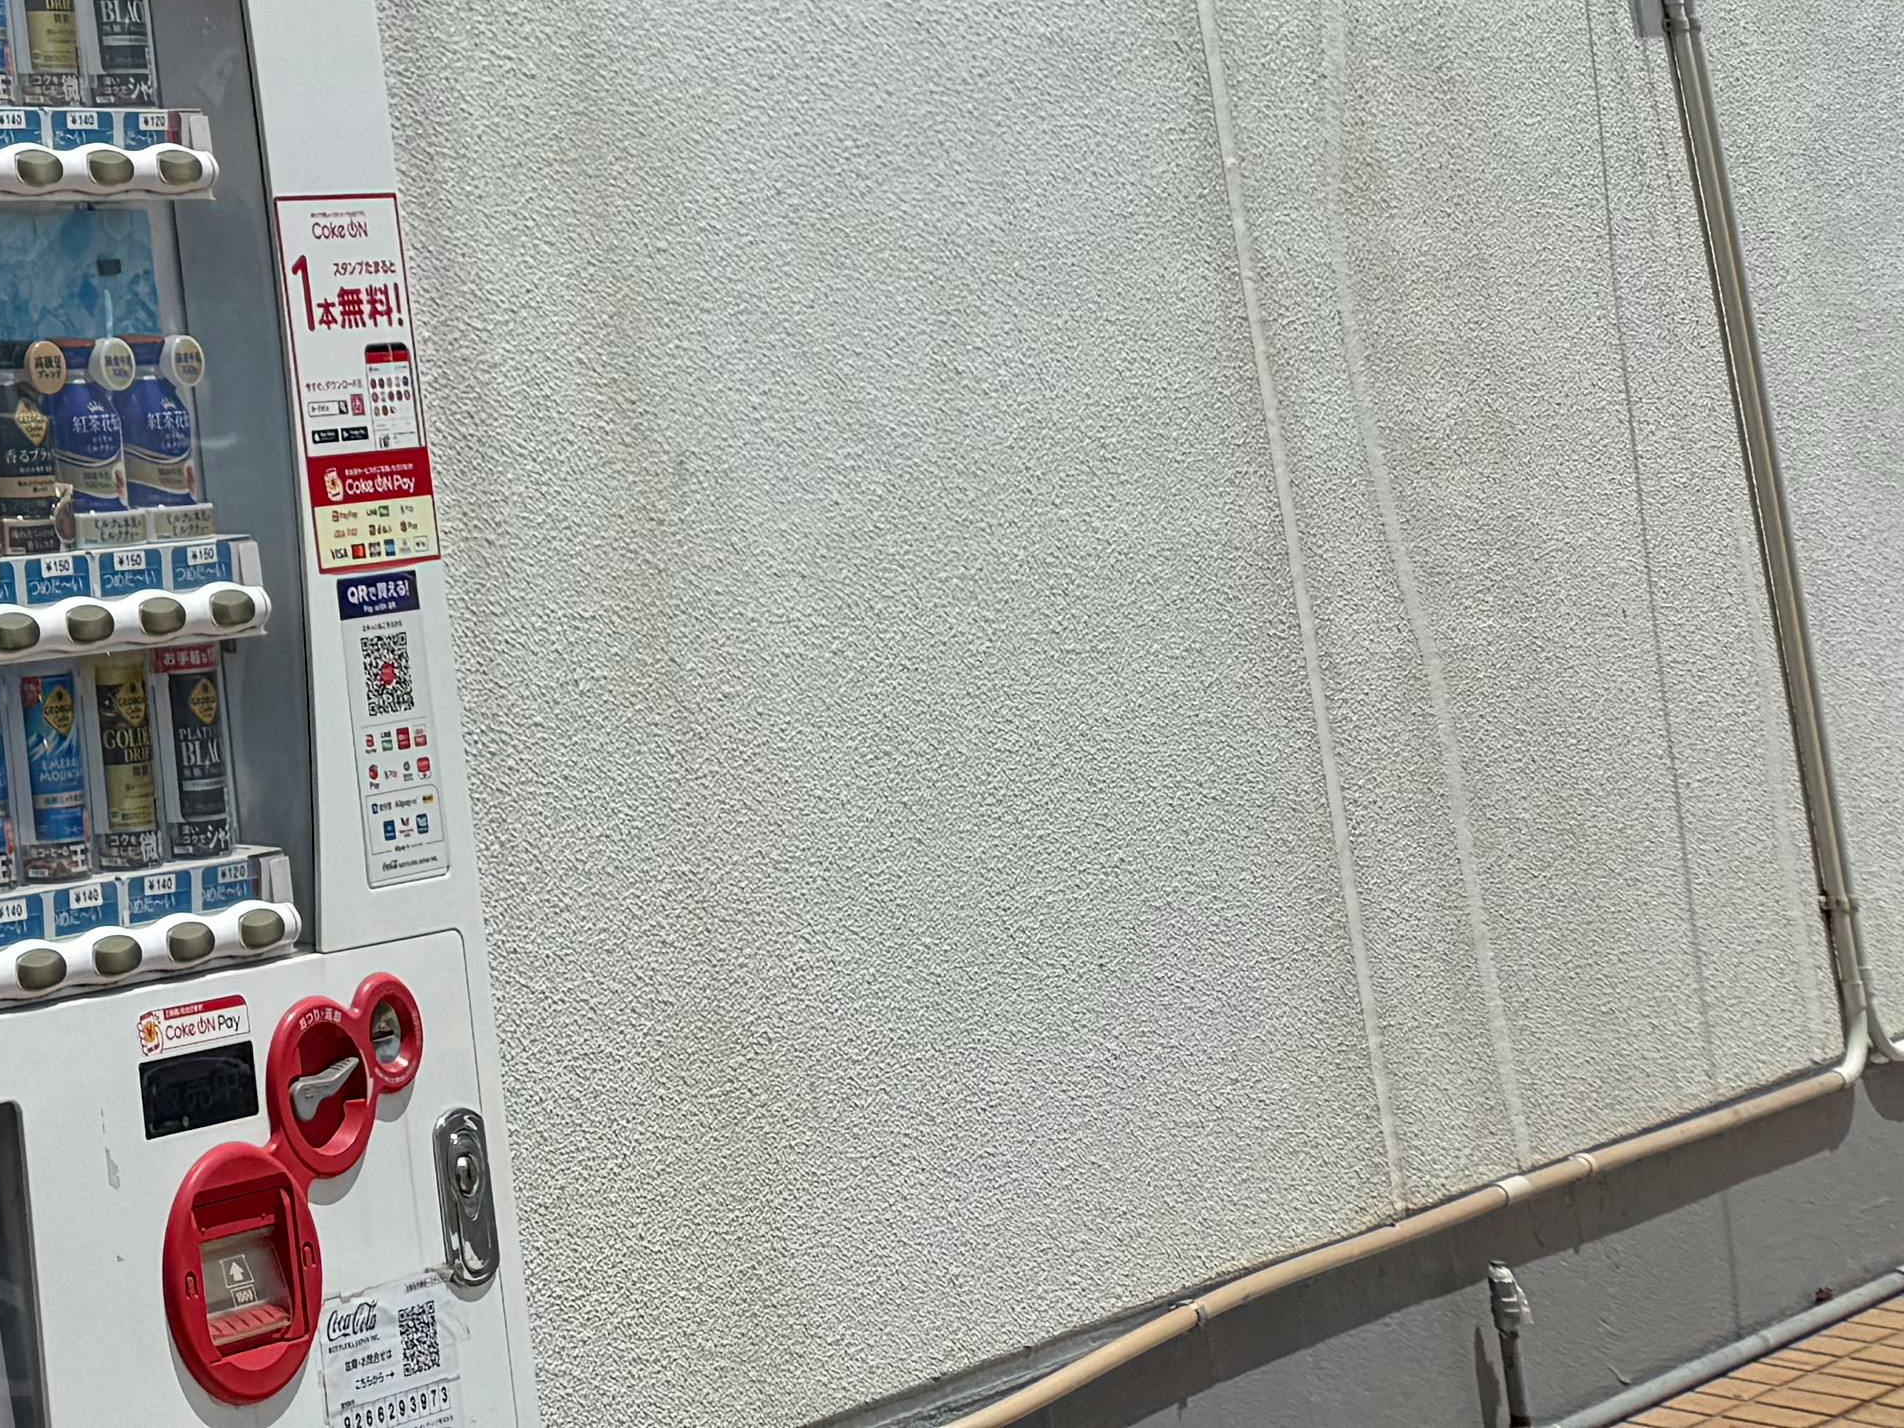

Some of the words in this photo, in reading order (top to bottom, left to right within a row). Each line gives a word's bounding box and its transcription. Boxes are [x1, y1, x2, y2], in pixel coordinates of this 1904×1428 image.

[311, 222, 346, 240] Coke
[348, 217, 369, 239] ON
[291, 254, 404, 332] 1本無料!
[345, 478, 374, 495] Coke
[375, 474, 393, 493] ON
[393, 473, 416, 494] Pay
[118, 551, 143, 568] ¥150
[190, 546, 215, 562] ¥150
[45, 558, 72, 574] ¥150
[346, 579, 410, 605] QRで買える!
[148, 876, 174, 891] ¥140
[73, 888, 99, 904] ¥140
[165, 1023, 196, 1042] Coke
[197, 1014, 216, 1036] ON
[217, 1013, 241, 1034] Pay
